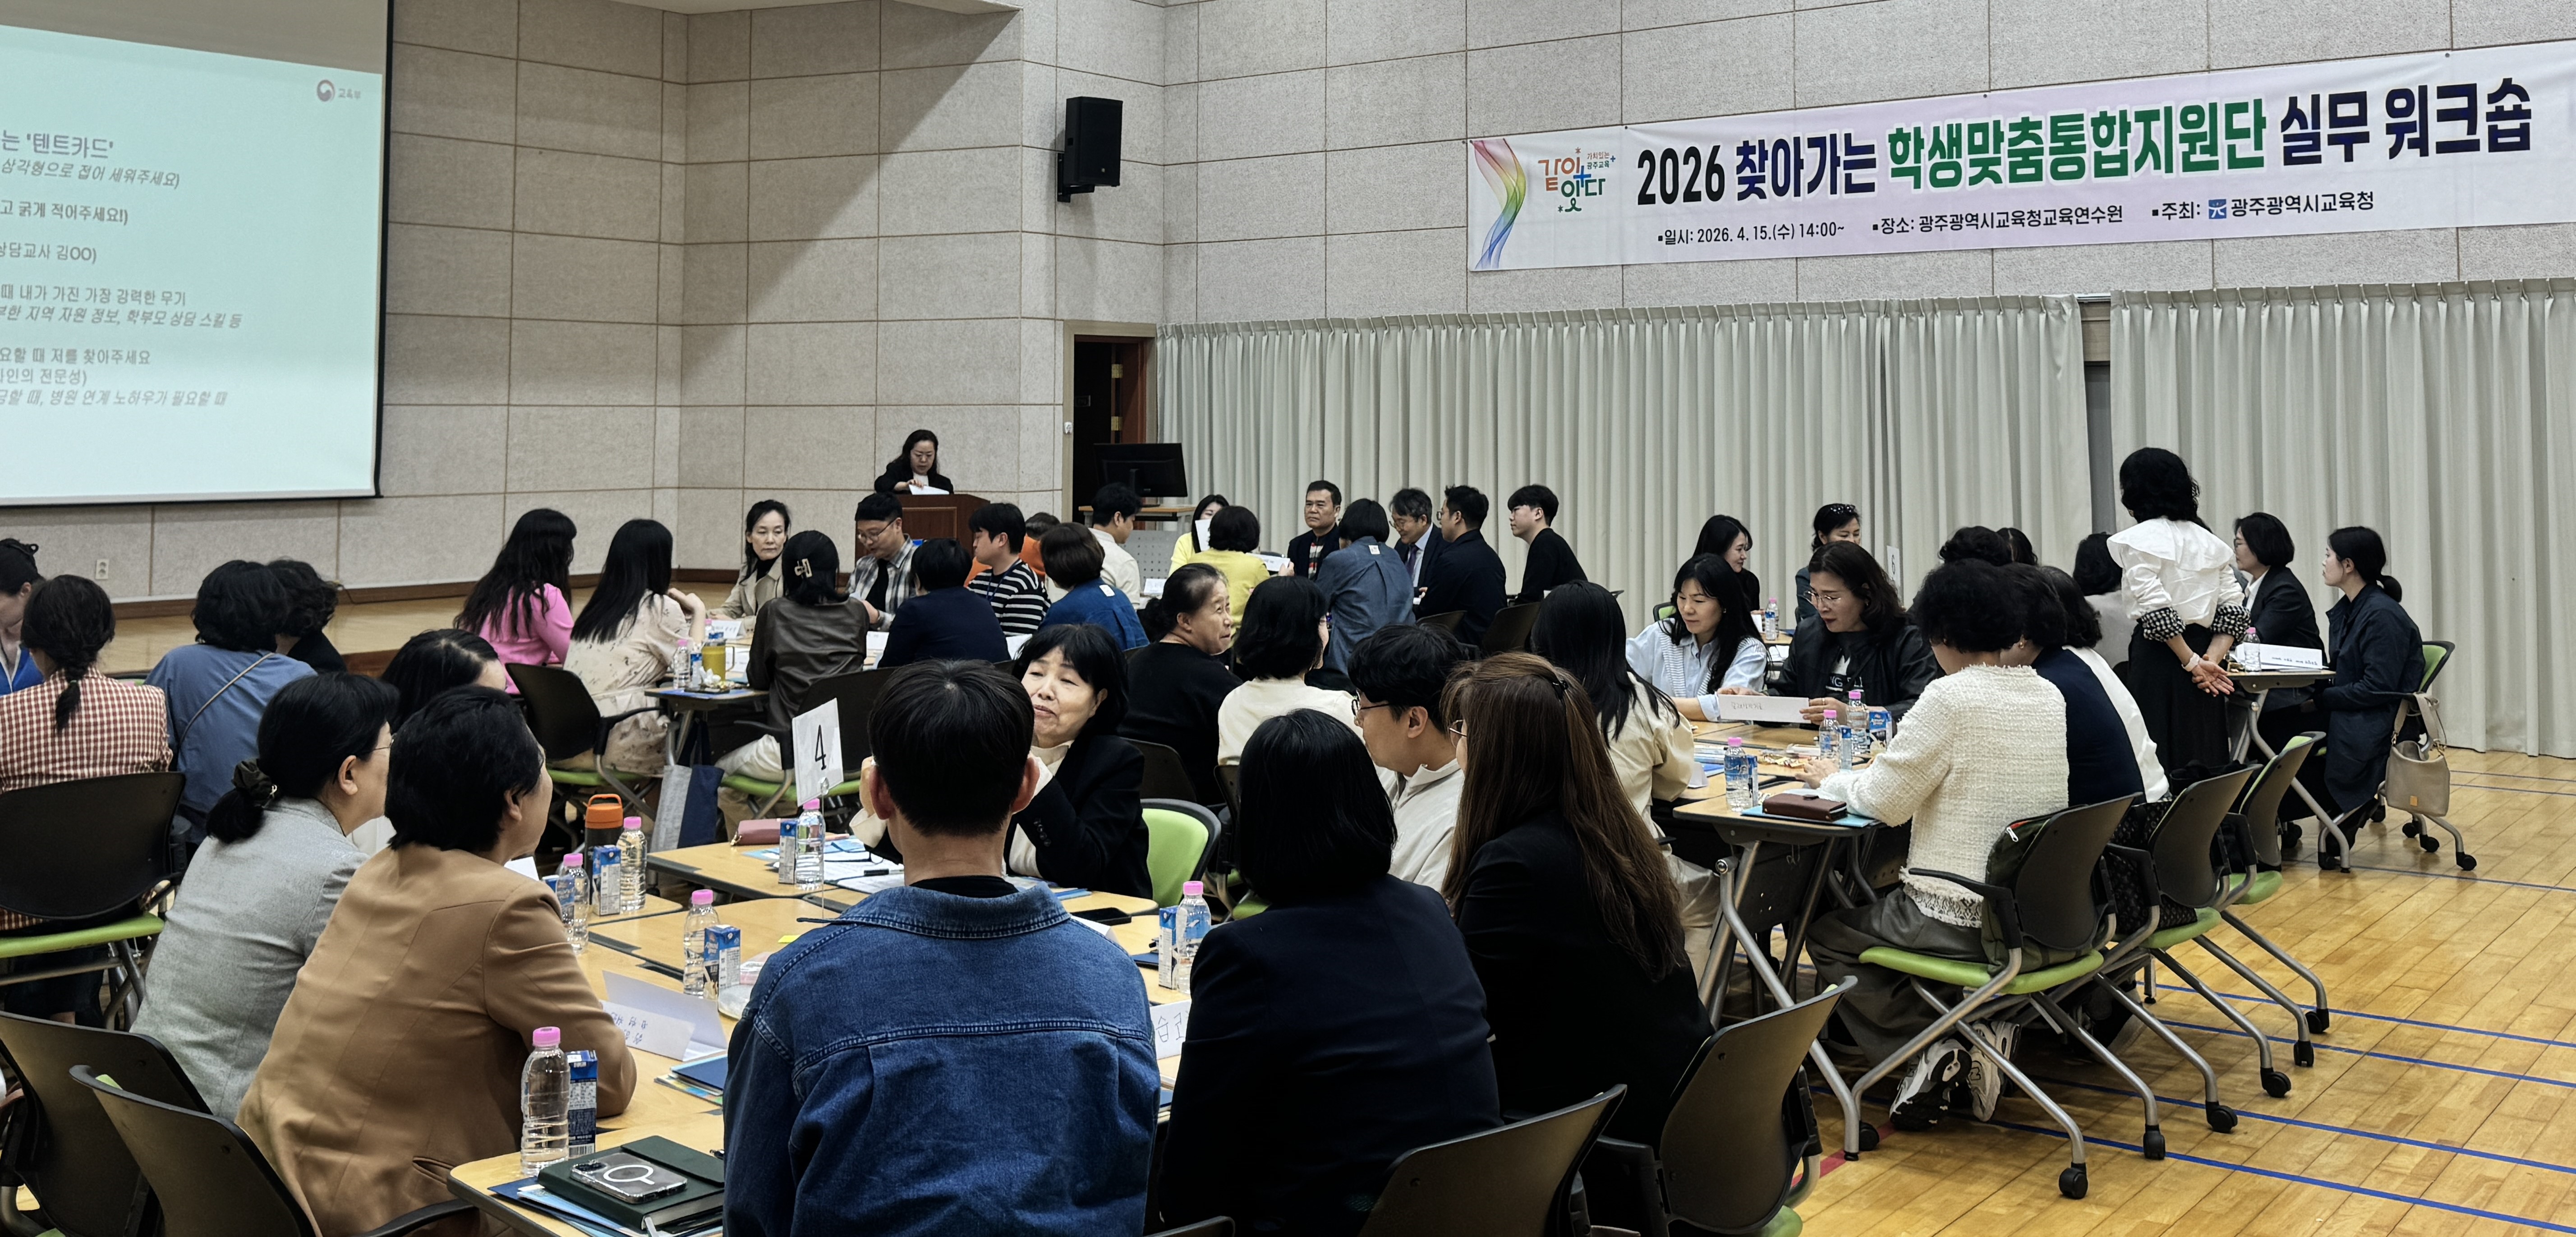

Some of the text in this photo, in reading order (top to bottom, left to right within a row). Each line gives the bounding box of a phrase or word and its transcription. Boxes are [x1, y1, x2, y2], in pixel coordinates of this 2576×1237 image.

[2, 130, 113, 158] 는 '텐트카드'
[1638, 77, 2531, 205] 2026 찾아가는 학생맞춤통합지원단 실무 워크숍
[1, 158, 180, 189] 삼각형으로 접어 세워주세요)
[0, 200, 128, 226] 고 굵게 적어주세요!)
[2162, 191, 2374, 221] 주최: 광주광역시교육청
[1881, 205, 2123, 234] 장소: 광주광역시교육청교육연수원
[1665, 222, 1845, 245] 일시: 2026. 4. 15.(수) 14:00~
[1, 284, 186, 306] 때 내가 가진 가장 강력한 무기
[25, 306, 55, 322] 지역
[59, 307, 87, 323] 자원
[91, 308, 120, 325] 정보,
[127, 309, 167, 325] 학부모
[170, 311, 197, 327] 상담
[199, 313, 226, 328] 스킬
[229, 314, 243, 328] 등
[32, 347, 45, 363] 때
[51, 348, 77, 364] 저를
[83, 349, 150, 365] 찾아주세요
[40, 368, 87, 387] 전문성)
[27, 389, 43, 407] 때,
[50, 390, 79, 406] 병원
[83, 390, 111, 406] 연계
[113, 390, 167, 406] 노하우가
[172, 391, 211, 406] 필요할
[214, 391, 228, 406] 때
[815, 724, 827, 771] 4
